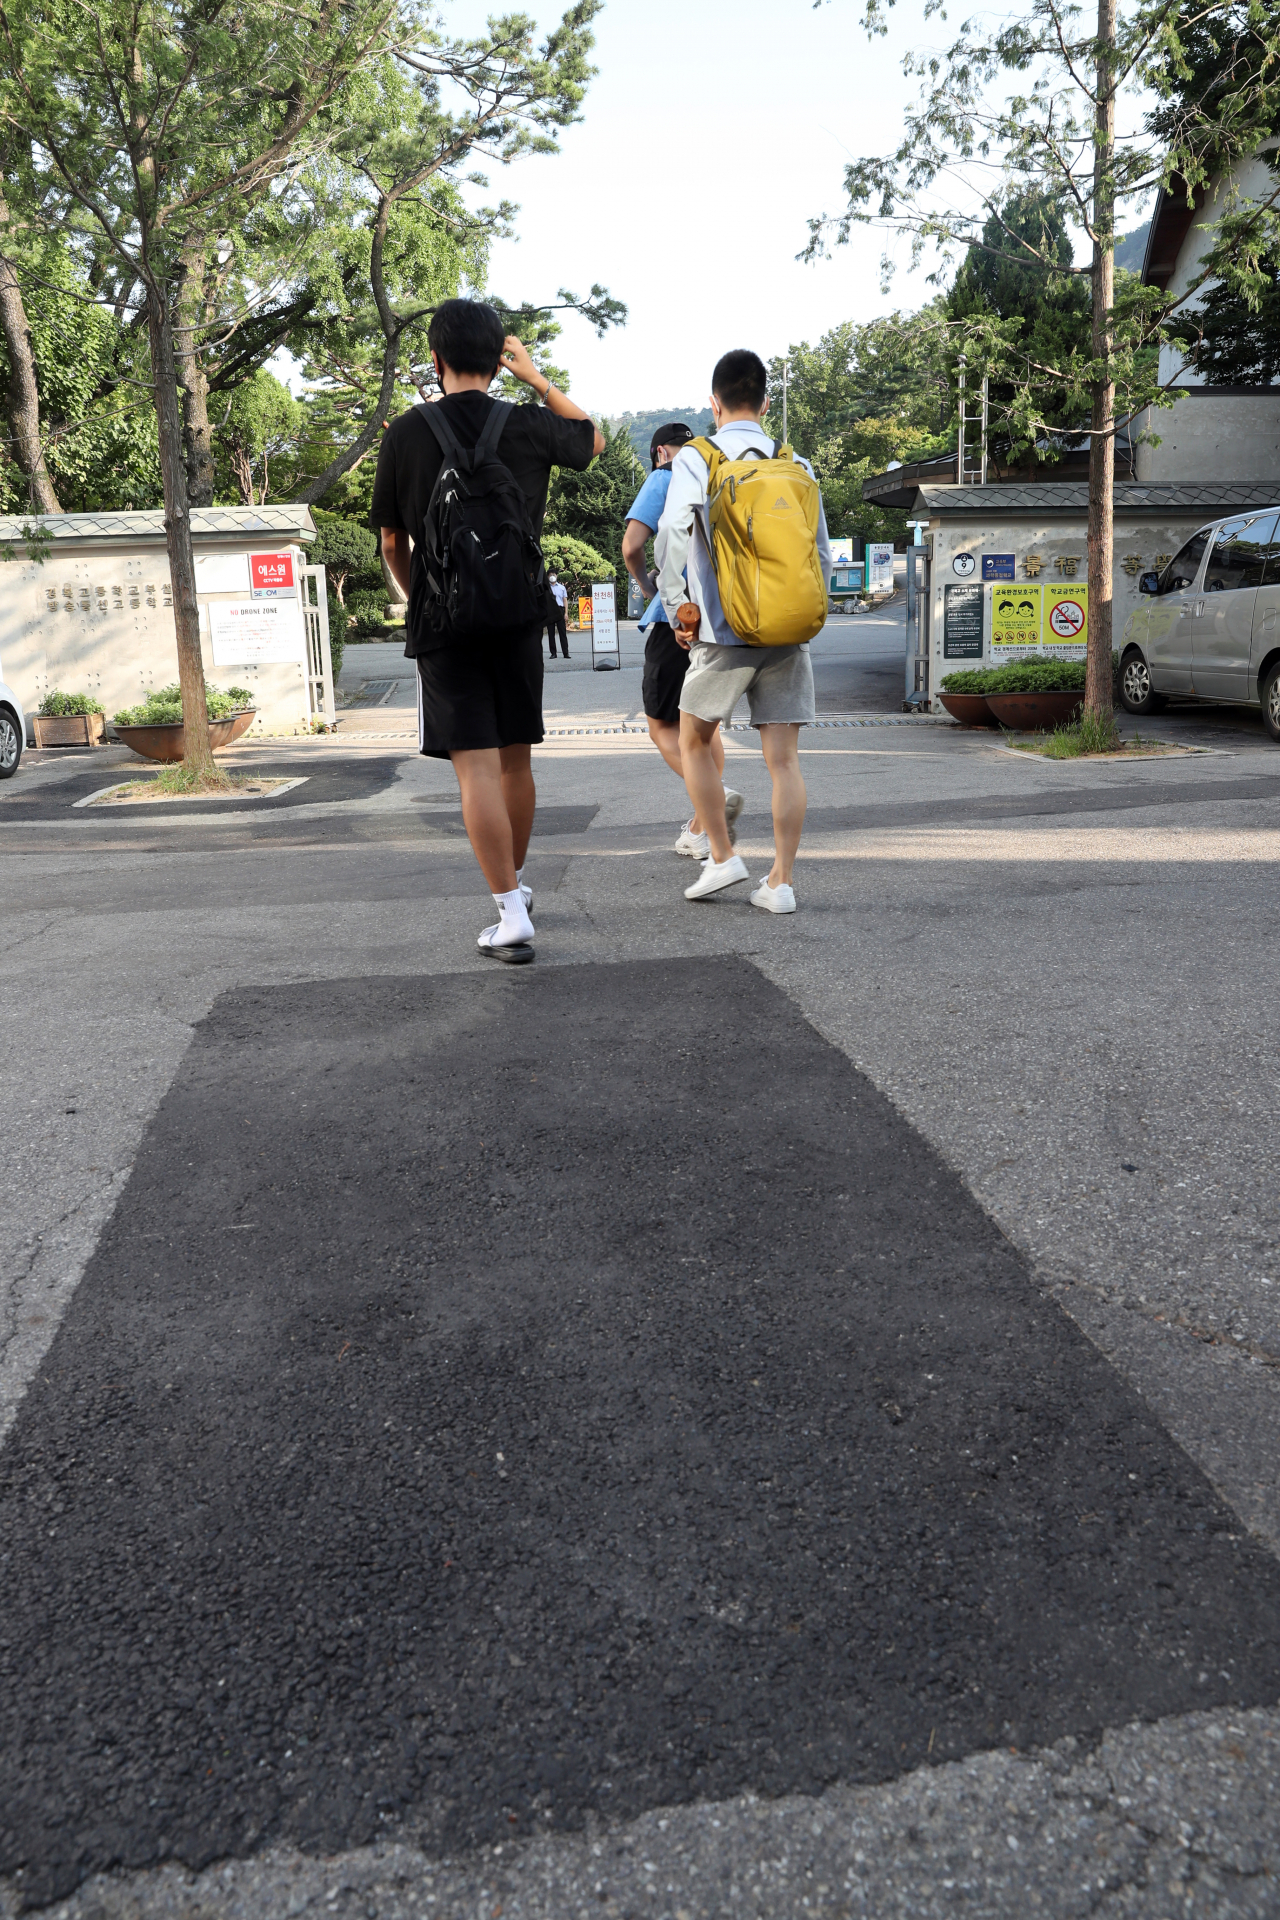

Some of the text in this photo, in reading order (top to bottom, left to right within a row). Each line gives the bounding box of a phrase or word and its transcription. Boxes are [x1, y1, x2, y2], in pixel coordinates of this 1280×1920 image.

[258, 563, 286, 576] 에스원
[594, 591, 613, 599] 천천히
[995, 588, 1039, 596] 교육환경보호구역
